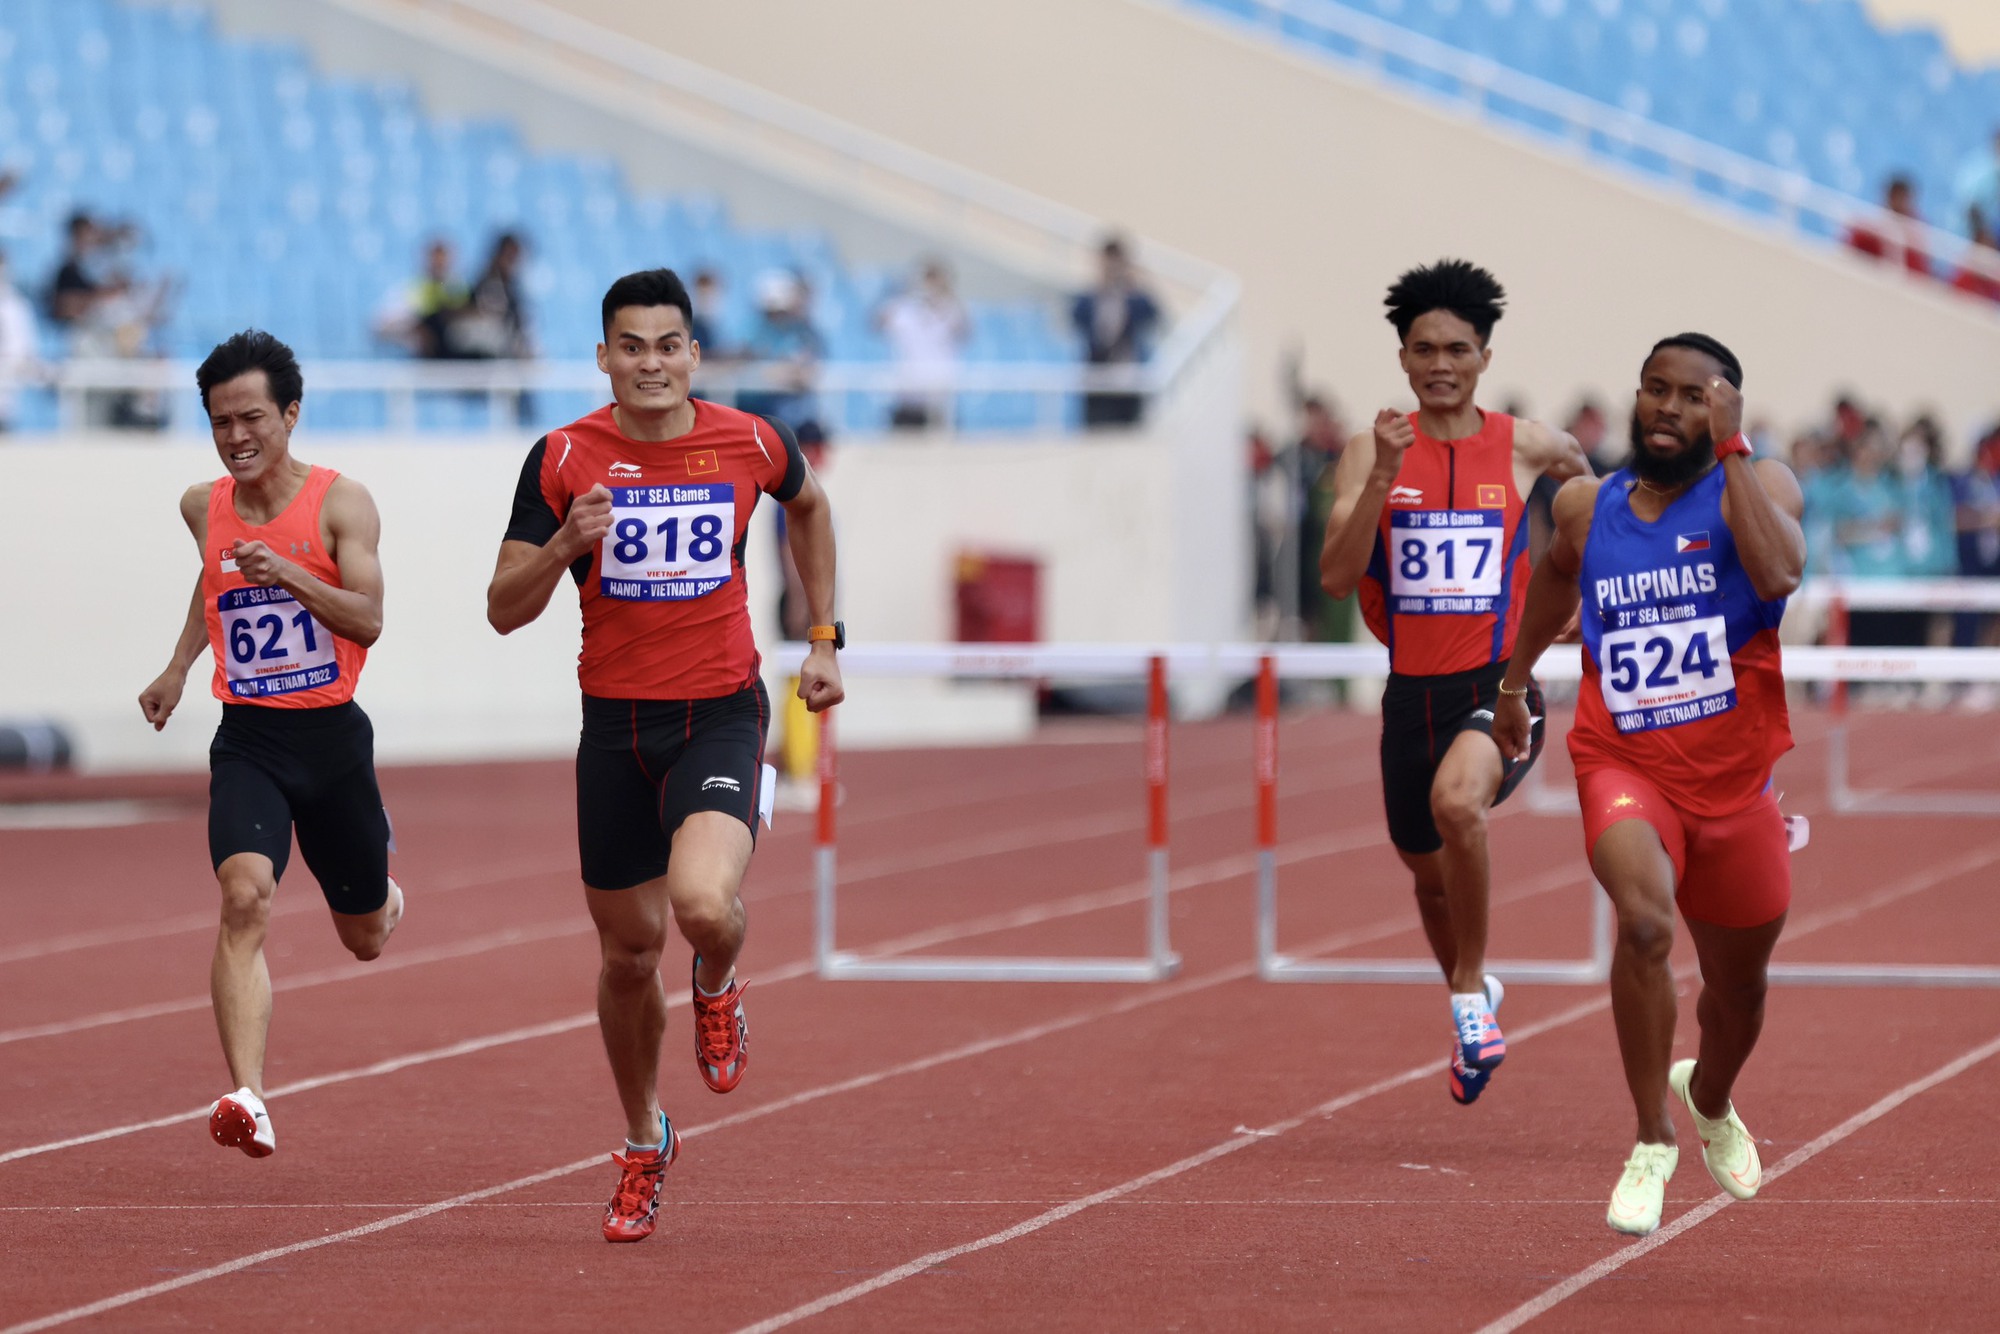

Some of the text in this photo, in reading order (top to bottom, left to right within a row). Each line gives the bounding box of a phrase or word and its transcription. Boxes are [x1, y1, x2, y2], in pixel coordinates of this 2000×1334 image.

[648, 488, 671, 504] SEA
[673, 487, 711, 503] Games
[1428, 512, 1448, 526] SEA
[1450, 511, 1484, 526] Games
[613, 514, 723, 564] 818
[1400, 538, 1493, 580] 817
[609, 581, 641, 598] HANOI
[650, 582, 695, 597] VIETNAM
[1596, 562, 1717, 609] PILIPINAS
[249, 588, 269, 604] SEA
[268, 587, 294, 601] Gam
[1400, 598, 1425, 611] HANOI
[1432, 598, 1473, 612] VIETNAM
[1638, 607, 1660, 624] SEA
[1661, 603, 1697, 621] Games
[230, 609, 317, 664] 621
[255, 663, 300, 675] SINGAPORE
[1609, 631, 1720, 693] 524
[266, 674, 307, 692] VIETNAM
[308, 668, 331, 685] 2022
[1637, 690, 1697, 706] PHILIPPINES
[1653, 703, 1701, 725] VIETNAM
[1702, 695, 1729, 715] 2022
[702, 783, 740, 792] LI-NING
